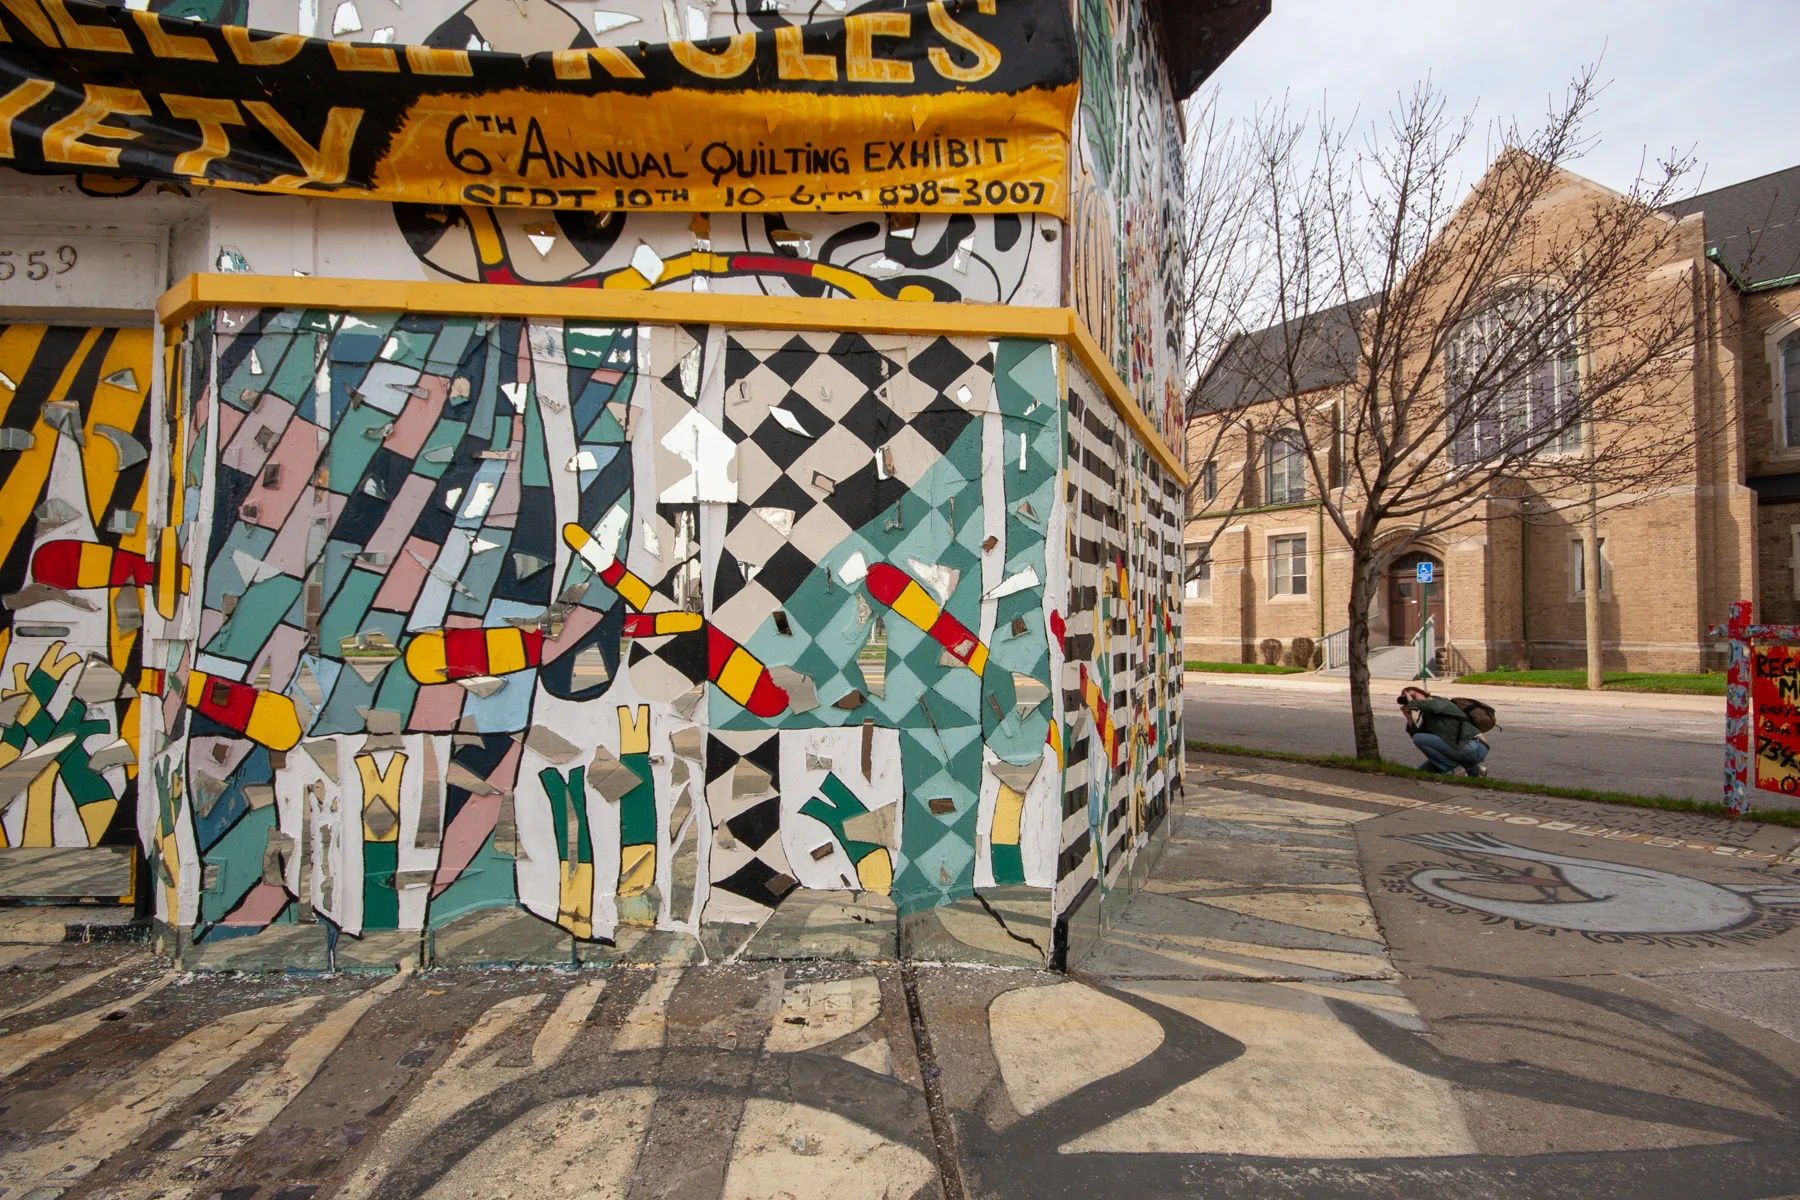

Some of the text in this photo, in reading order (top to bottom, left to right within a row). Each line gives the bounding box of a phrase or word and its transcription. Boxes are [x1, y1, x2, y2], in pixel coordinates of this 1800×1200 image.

[445, 114, 517, 175] 6TH
[518, 116, 689, 180] ANNUAL
[0, 245, 77, 281] 559
[1756, 654, 1800, 679] REG
